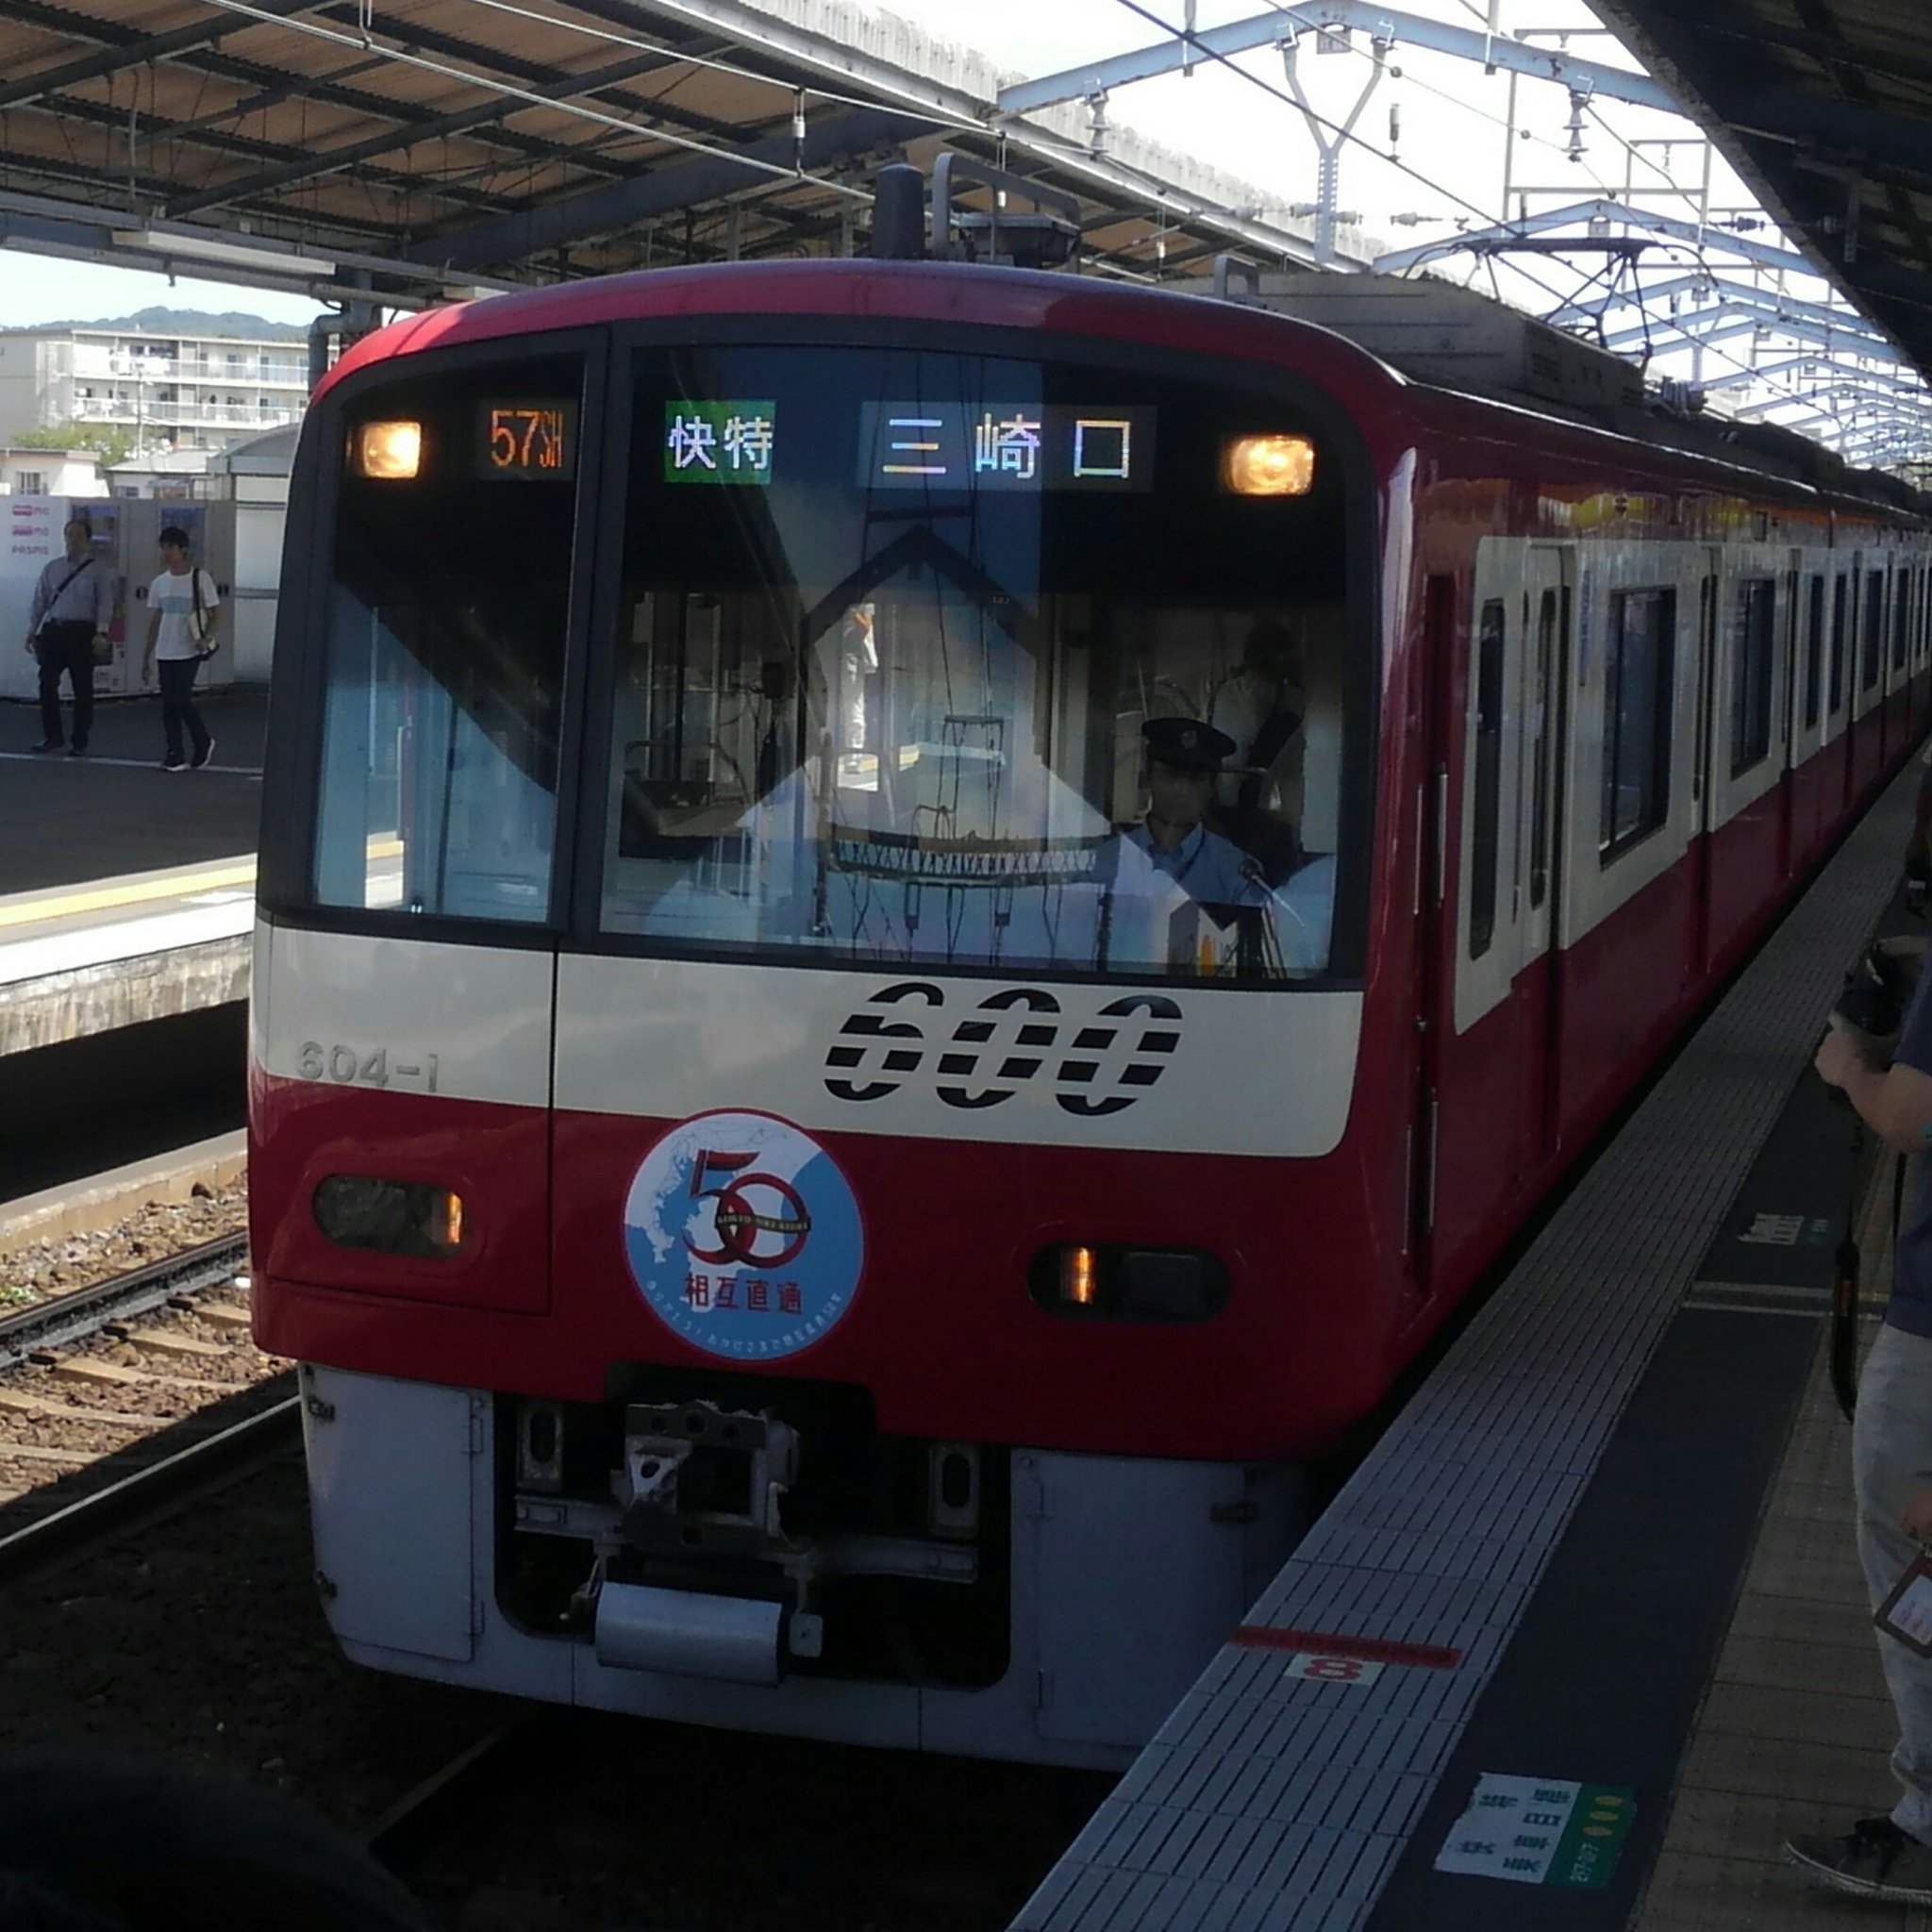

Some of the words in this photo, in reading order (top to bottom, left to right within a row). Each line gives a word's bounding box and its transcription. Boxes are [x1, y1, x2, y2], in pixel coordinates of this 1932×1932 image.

[668, 415, 774, 469] 快特
[883, 413, 1130, 478] 三崎口
[297, 1041, 438, 1093] 604-1
[824, 981, 1183, 1116] 600
[684, 1274, 802, 1315] 相互直通
[1304, 1657, 1362, 1680] 8
